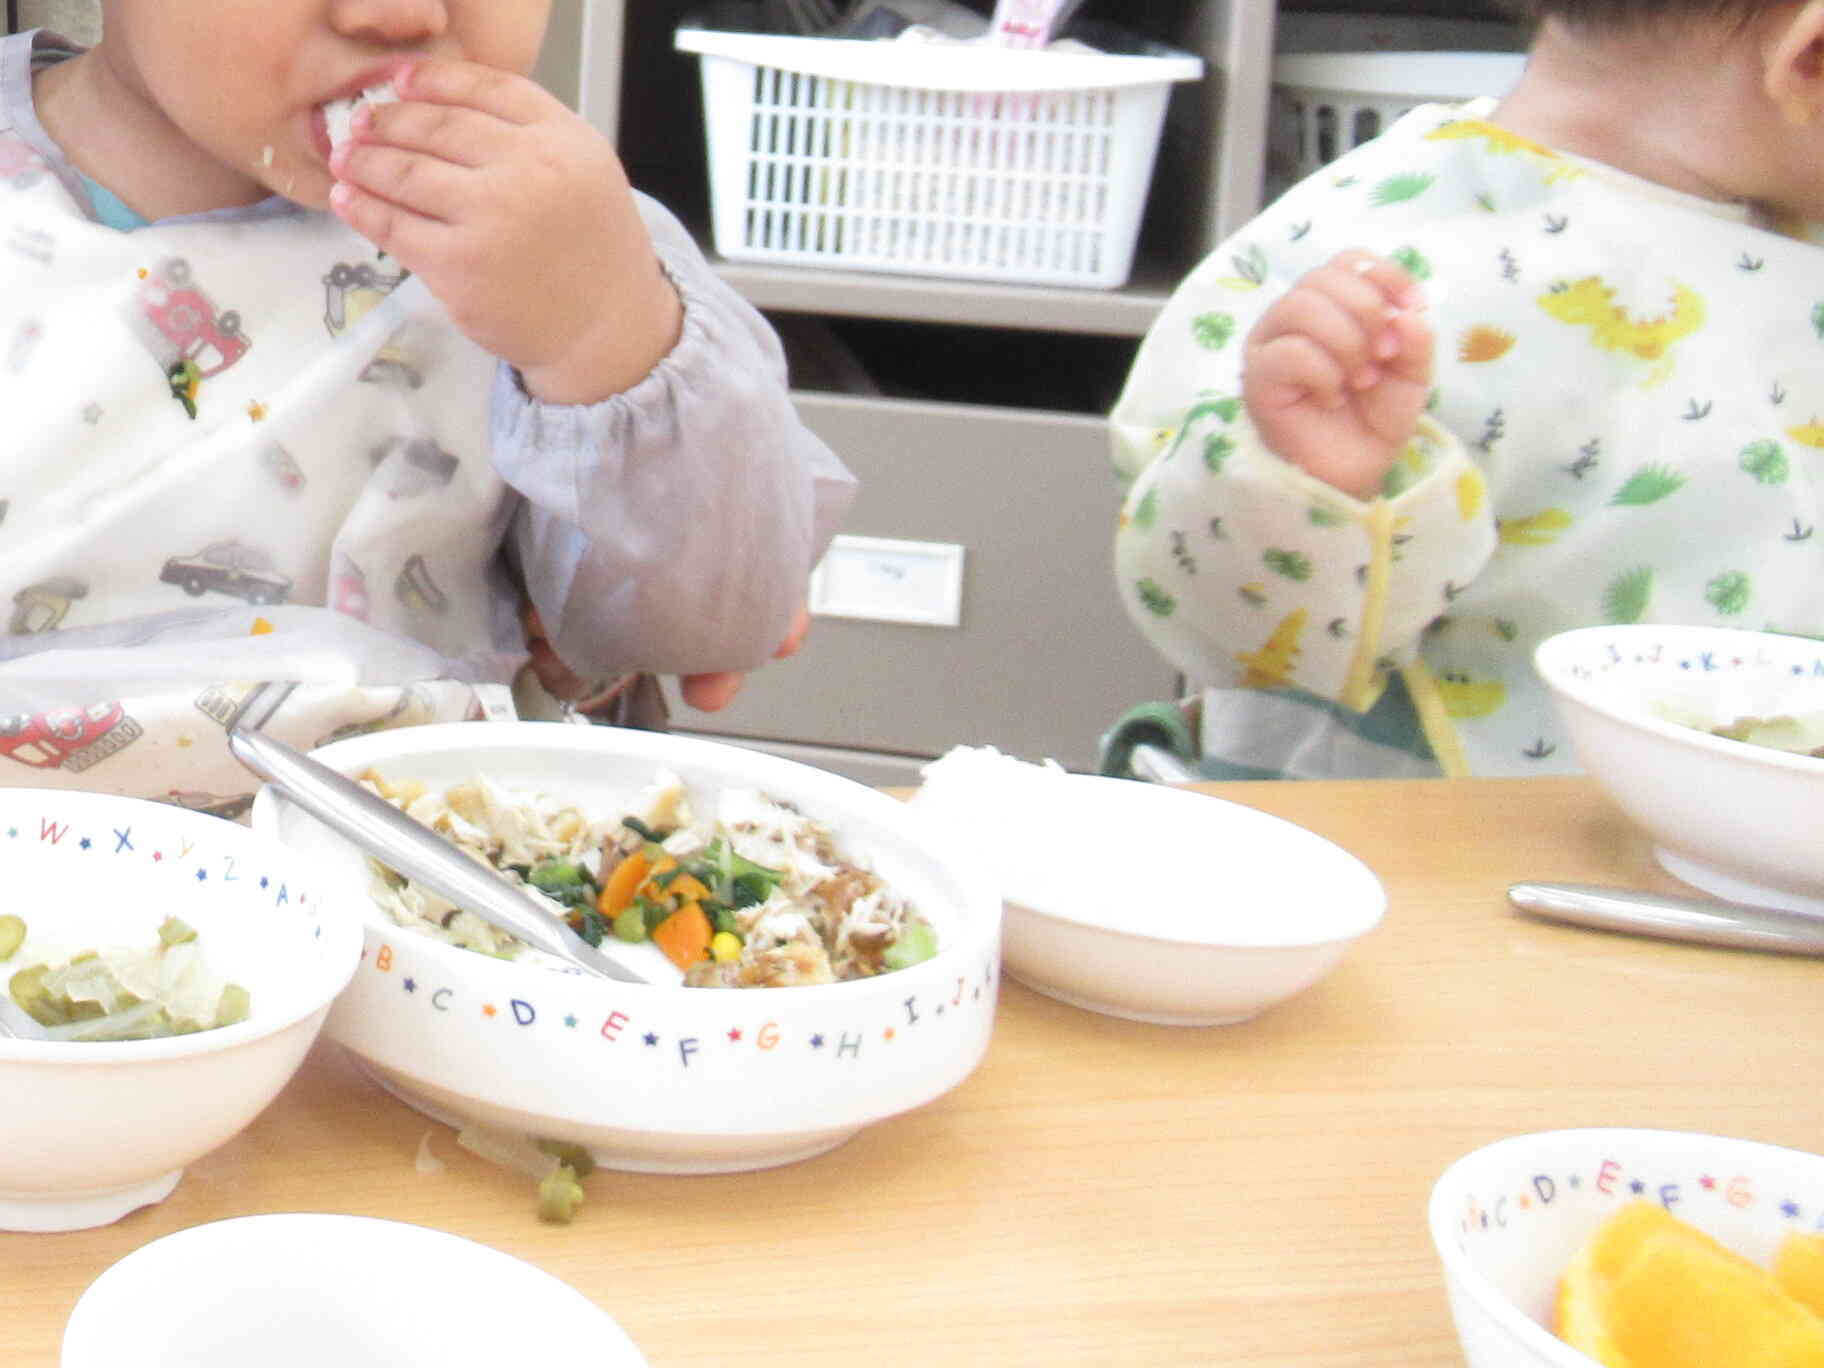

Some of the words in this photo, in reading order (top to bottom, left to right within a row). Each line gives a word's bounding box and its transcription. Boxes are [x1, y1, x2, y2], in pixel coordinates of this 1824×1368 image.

[1700, 651, 1719, 672] K
[39, 816, 69, 846] W
[112, 826, 135, 854] X
[276, 882, 289, 907] A
[376, 943, 394, 973] B
[431, 987, 454, 1012] C
[509, 998, 536, 1026] D
[600, 1010, 631, 1042] E
[678, 1037, 700, 1068] F
[756, 1022, 781, 1051] G
[835, 1031, 864, 1059] H
[903, 994, 920, 1024] I
[951, 976, 967, 1006] J
[1532, 1173, 1556, 1204] D
[1596, 1159, 1623, 1196] E
[1658, 1183, 1681, 1211] F
[1725, 1175, 1753, 1209] G
